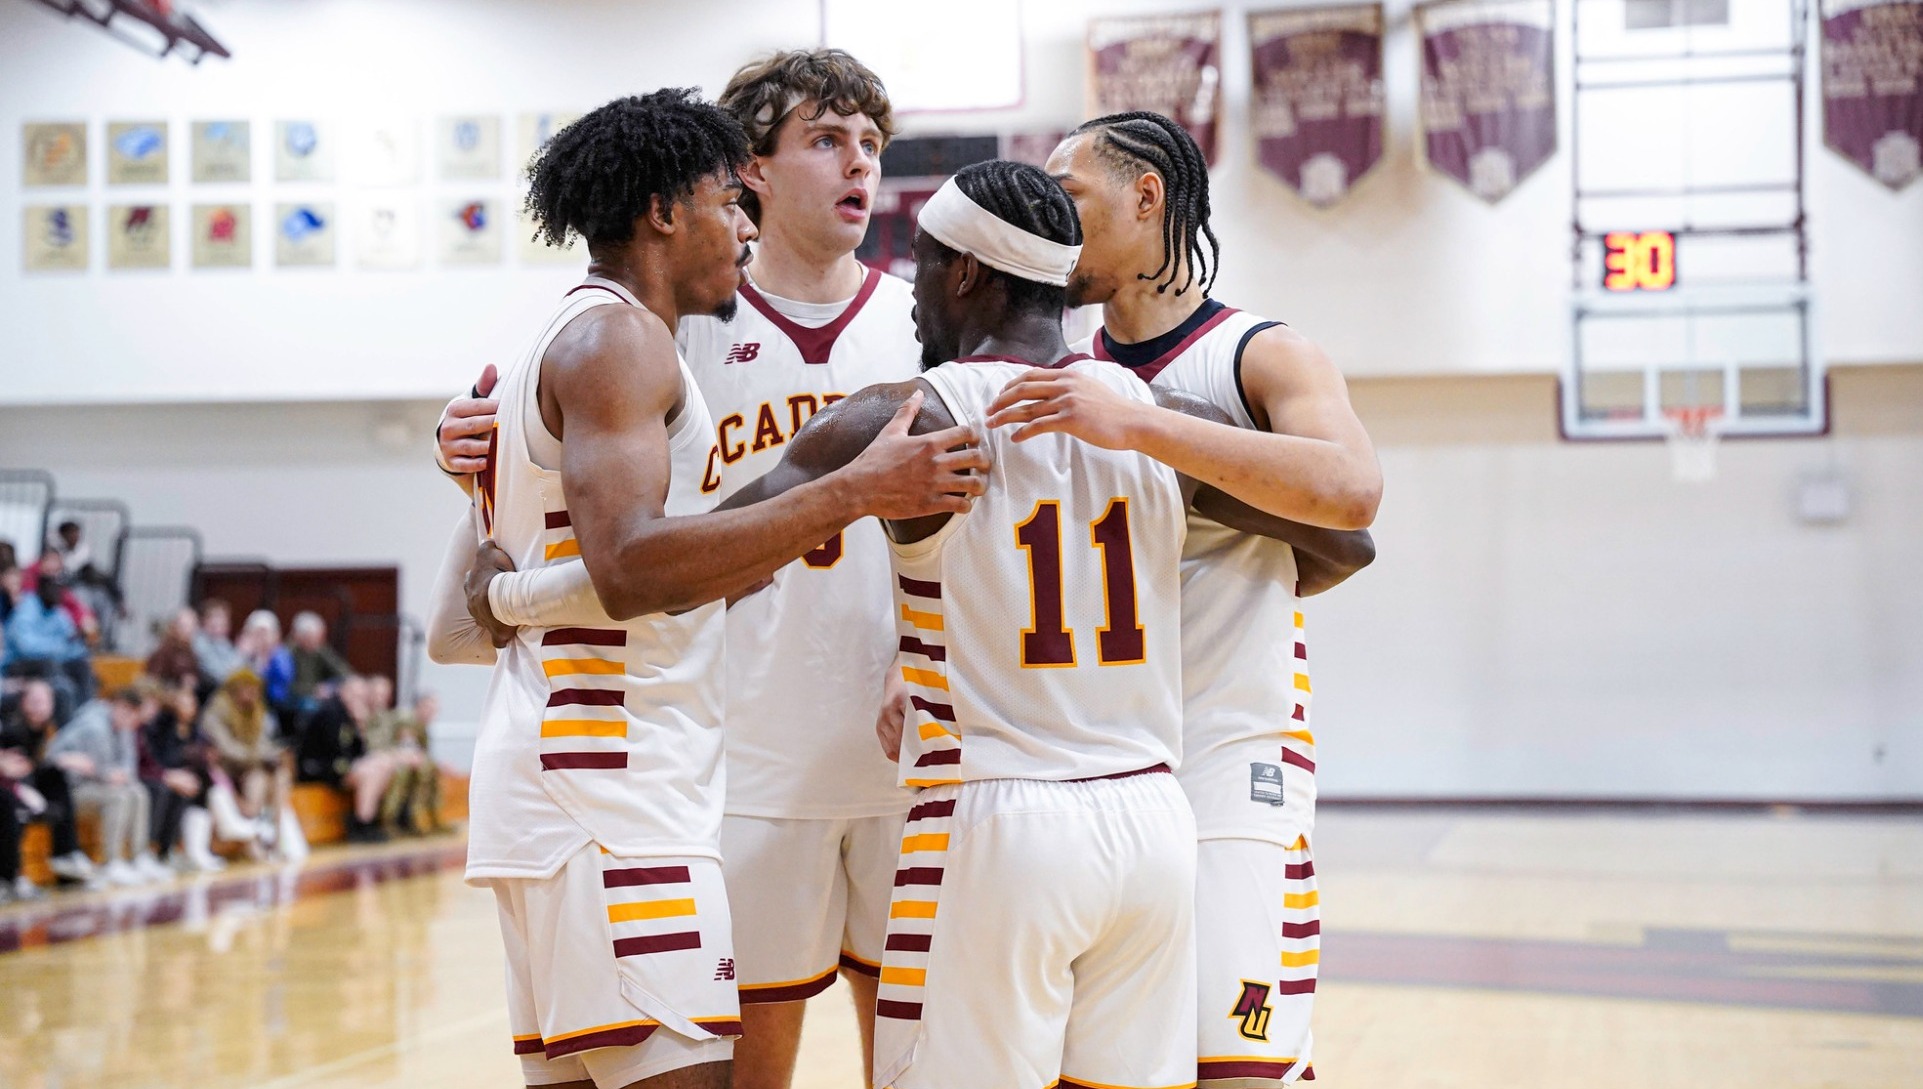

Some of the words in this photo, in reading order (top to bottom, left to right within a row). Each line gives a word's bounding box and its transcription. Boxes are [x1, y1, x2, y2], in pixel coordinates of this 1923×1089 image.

[1604, 230, 1675, 291] 30
[724, 343, 760, 364] NB
[718, 392, 848, 465] CAD
[1014, 496, 1147, 668] 11
[1228, 979, 1274, 1043] NU
